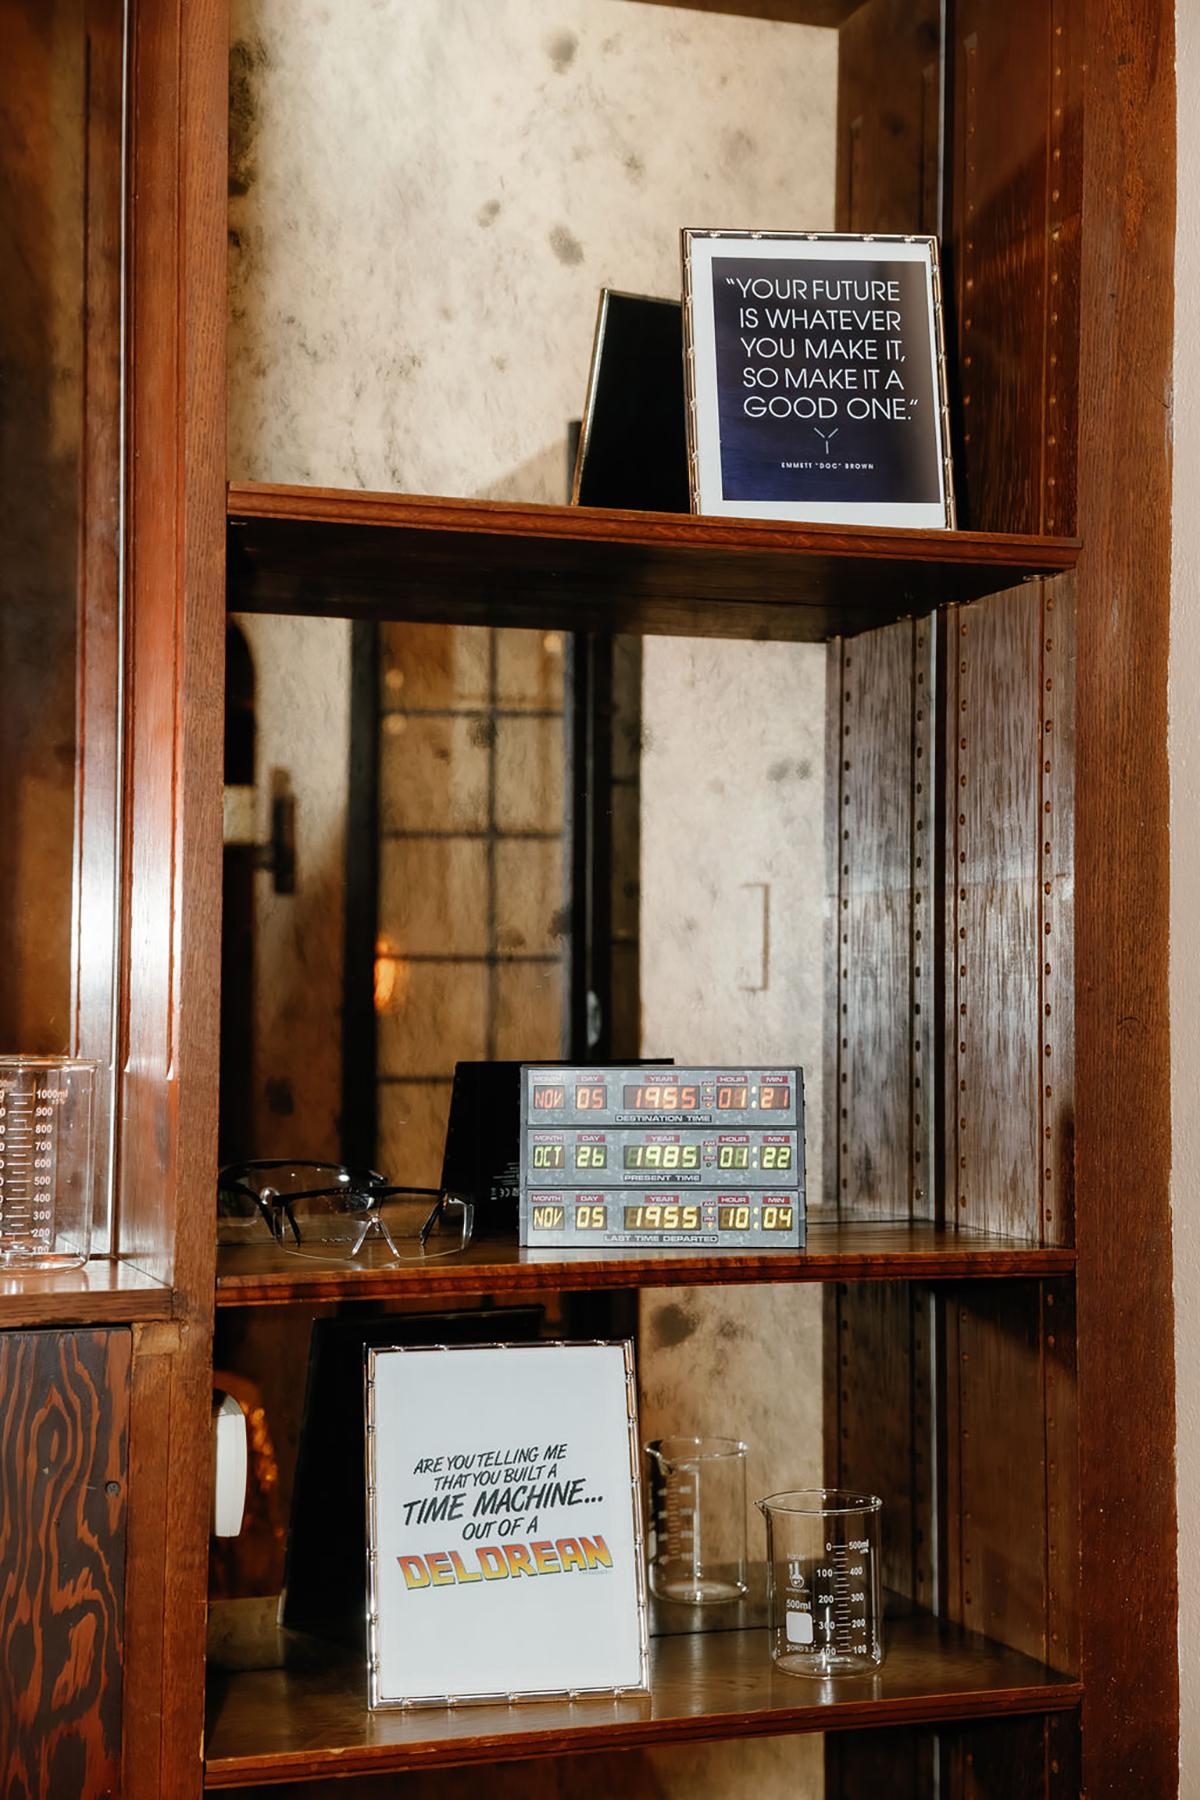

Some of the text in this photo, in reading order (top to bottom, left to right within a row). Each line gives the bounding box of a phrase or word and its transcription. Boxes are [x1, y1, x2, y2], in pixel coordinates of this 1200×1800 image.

[813, 280, 900, 301] FUTURE
[740, 308, 901, 331] IS WHATEVER
[740, 337, 906, 362] YOU MAKE IT,
[742, 368, 905, 390] SO MAKE IT A
[743, 396, 838, 419] GOOD
[36, 1089, 68, 1099] 1000ml
[535, 1089, 562, 1109] NOV
[577, 1087, 604, 1109] 05
[636, 1087, 696, 1109] 1955
[36, 1107, 52, 1116] 900
[35, 1125, 52, 1134] 800
[35, 1142, 52, 1150] 700
[534, 1146, 562, 1166] OCT
[577, 1146, 605, 1167] 26
[636, 1146, 698, 1168] 1985
[34, 1160, 51, 1168] 600
[34, 1177, 50, 1185] 500
[33, 1194, 50, 1203] 400
[33, 1211, 50, 1220] 300
[533, 1207, 562, 1227] NOV
[576, 1207, 604, 1228] 05
[636, 1207, 697, 1229] 1955
[32, 1229, 50, 1237] 200
[413, 1443, 568, 1475] ARE YOU TELLING ME
[434, 1463, 558, 1491] THAT YOU BUILT A
[403, 1478, 603, 1526] TIME MACHINE...
[462, 1515, 539, 1541] OUT OF A
[849, 1539, 870, 1550] 500ml
[396, 1535, 614, 1590] DELOREAN
[816, 1566, 863, 1578] 100 400
[818, 1592, 864, 1604] 200 300
[786, 1600, 811, 1610] 500ml
[852, 1618, 866, 1628] 200
[853, 1645, 867, 1654] 100
